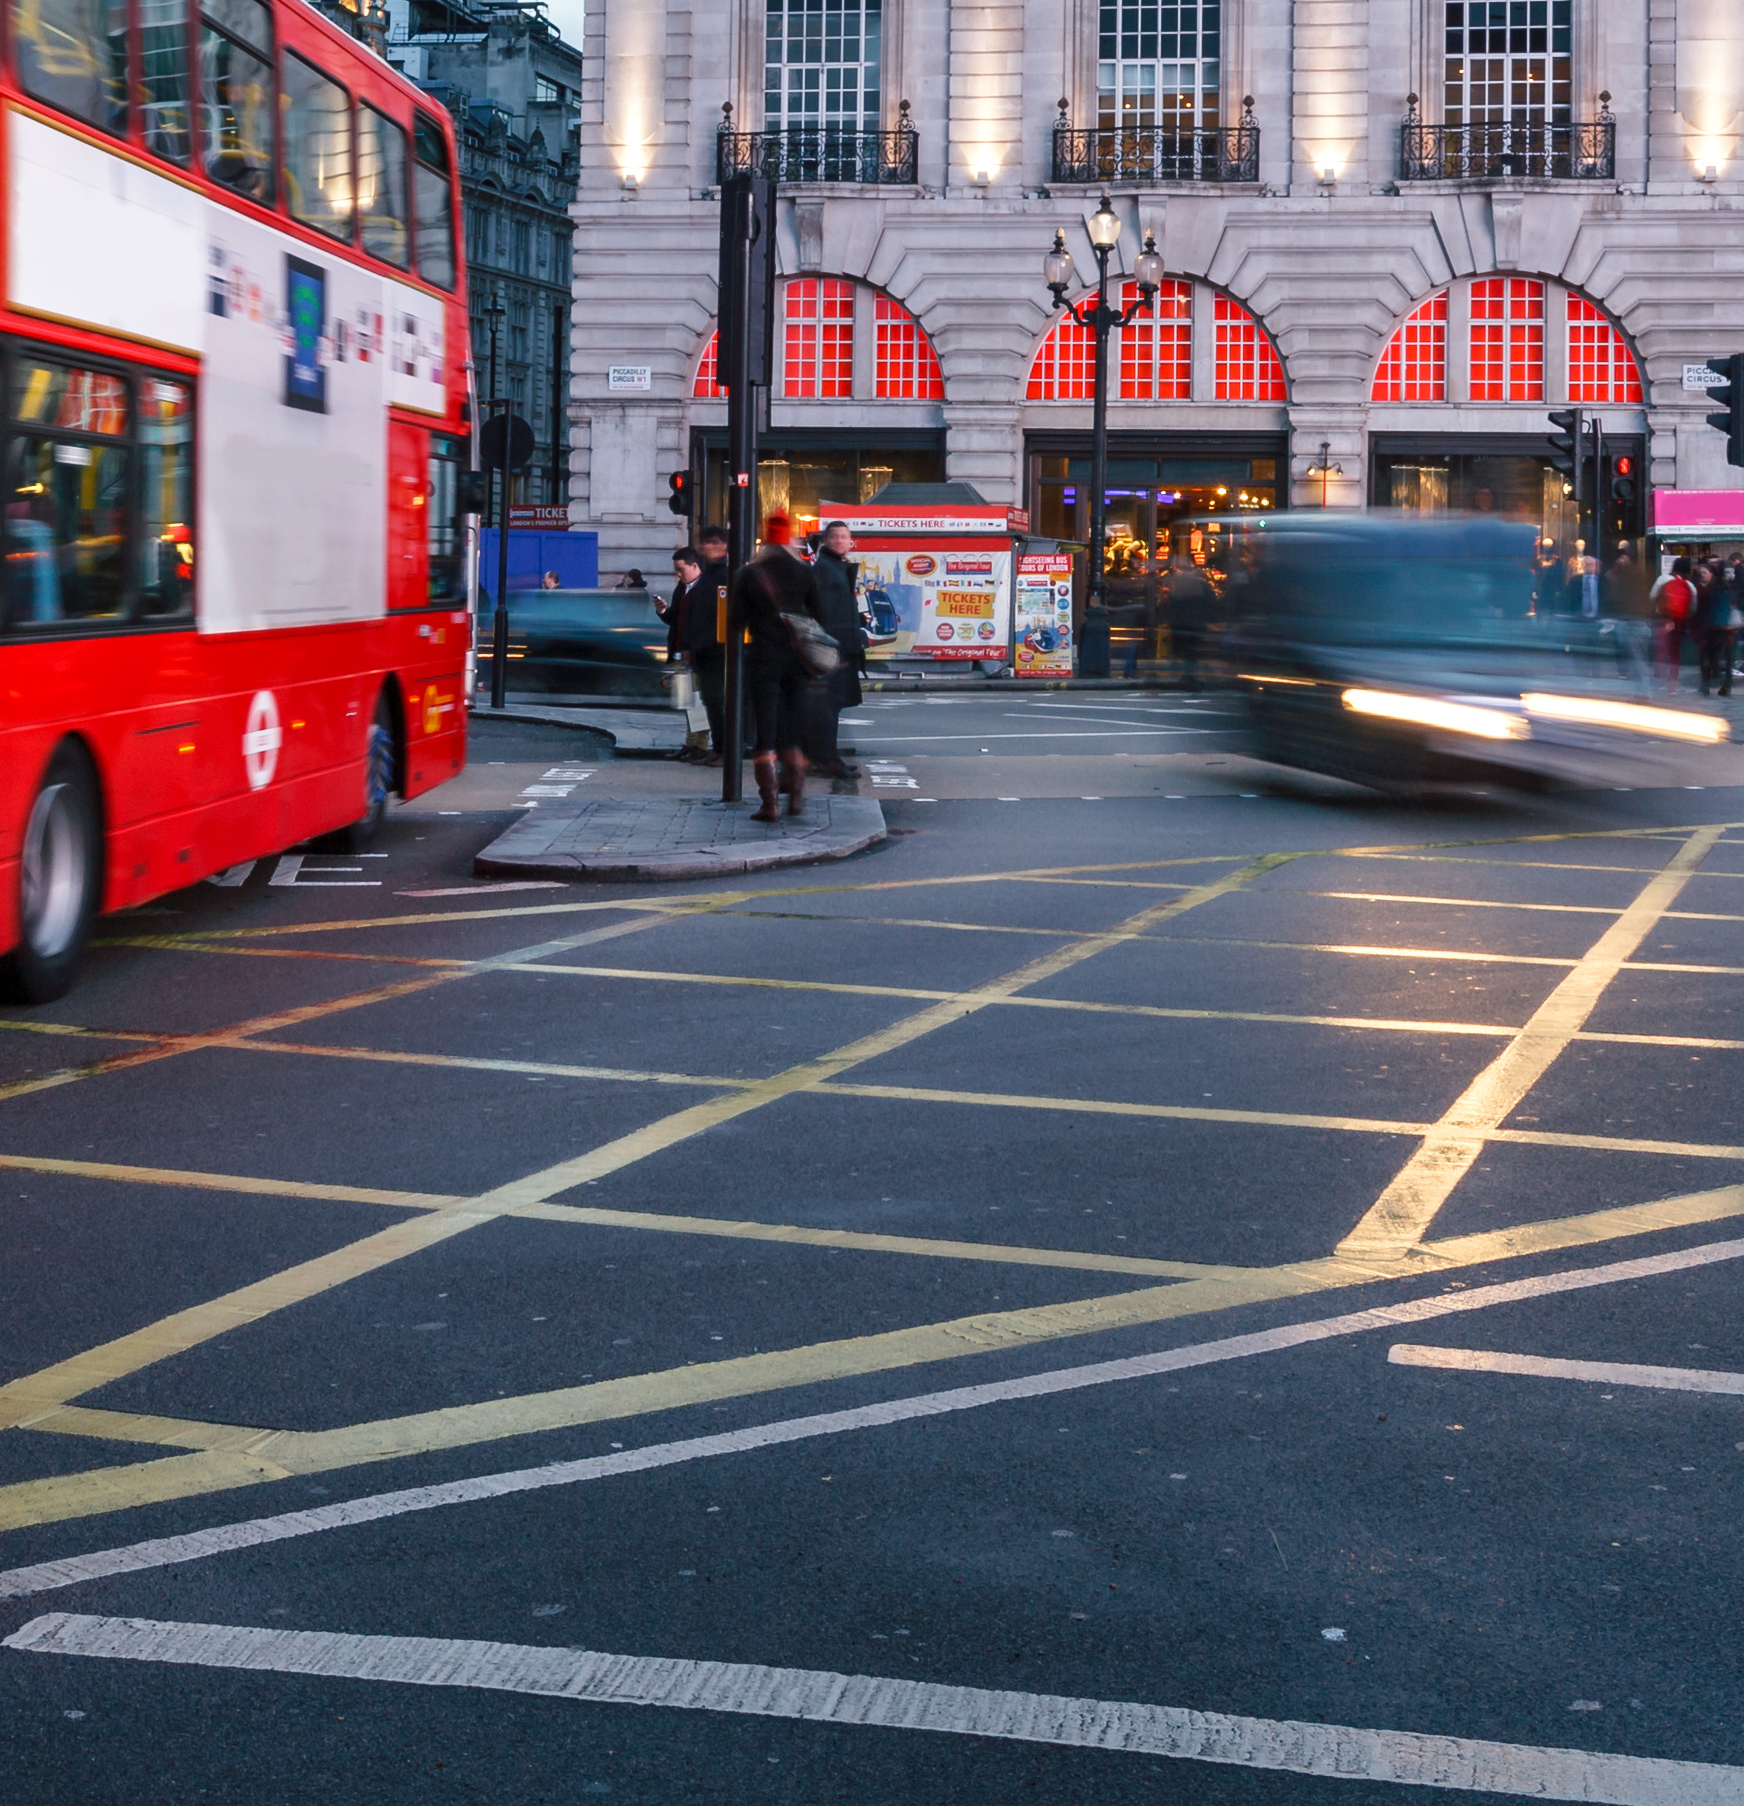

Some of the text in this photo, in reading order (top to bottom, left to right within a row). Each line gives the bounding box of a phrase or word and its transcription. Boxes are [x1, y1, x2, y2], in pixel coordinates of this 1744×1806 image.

[1686, 375, 1722, 383] CIRCUS
[877, 519, 946, 528] TICKETS HERE
[941, 592, 991, 605] TICKETS
[949, 604, 981, 615] HERE
